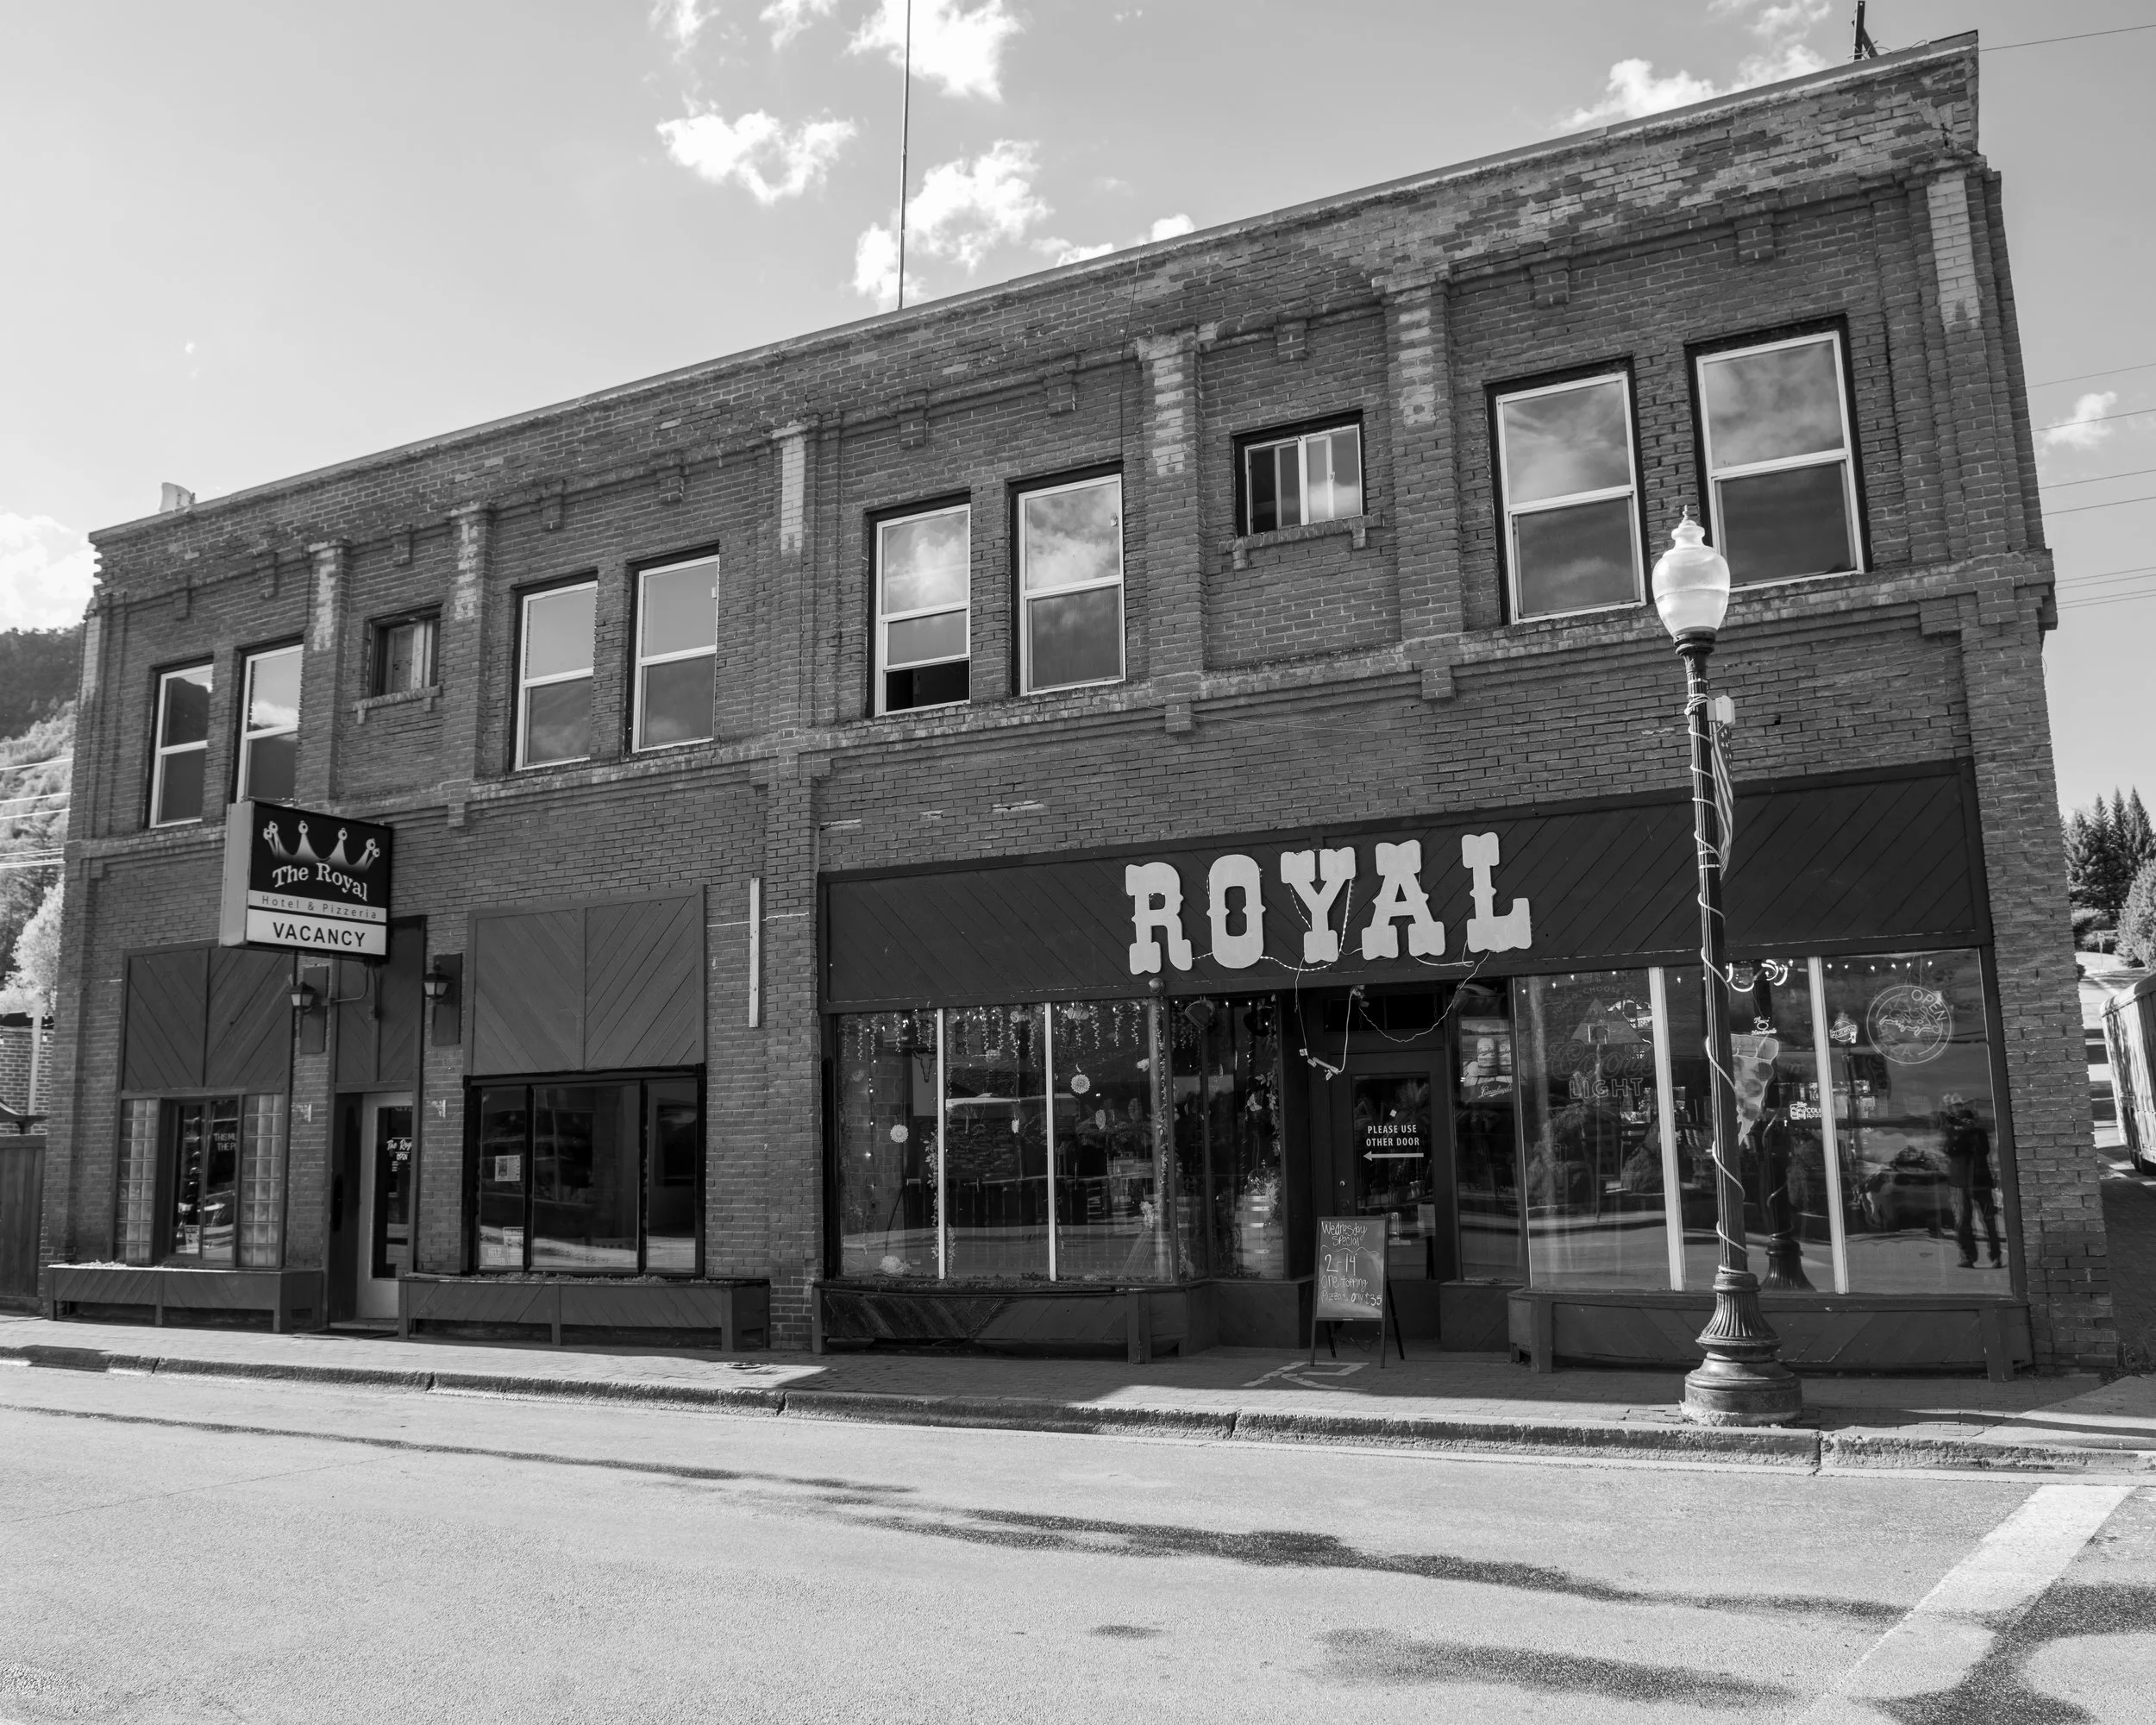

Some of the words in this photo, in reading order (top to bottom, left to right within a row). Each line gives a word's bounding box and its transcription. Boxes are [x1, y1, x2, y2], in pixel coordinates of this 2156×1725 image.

[272, 865, 309, 888] The
[316, 862, 367, 901] Royal
[261, 895, 299, 909] Hotel
[308, 901, 315, 911] &
[323, 903, 377, 919] Pizzeria
[1125, 831, 1532, 975] ROYAL
[273, 922, 366, 947] VACANCY
[1911, 989, 1948, 1021] OPEN
[1569, 1078, 1644, 1100] LIGHT
[1367, 1125, 1398, 1134] PLEASE
[1401, 1124, 1417, 1133] USE
[1366, 1138, 1394, 1147] OTHER
[1396, 1137, 1420, 1146] DOOR
[1320, 1220, 1368, 1240] Wednesday
[1341, 1275, 1369, 1292] topping
